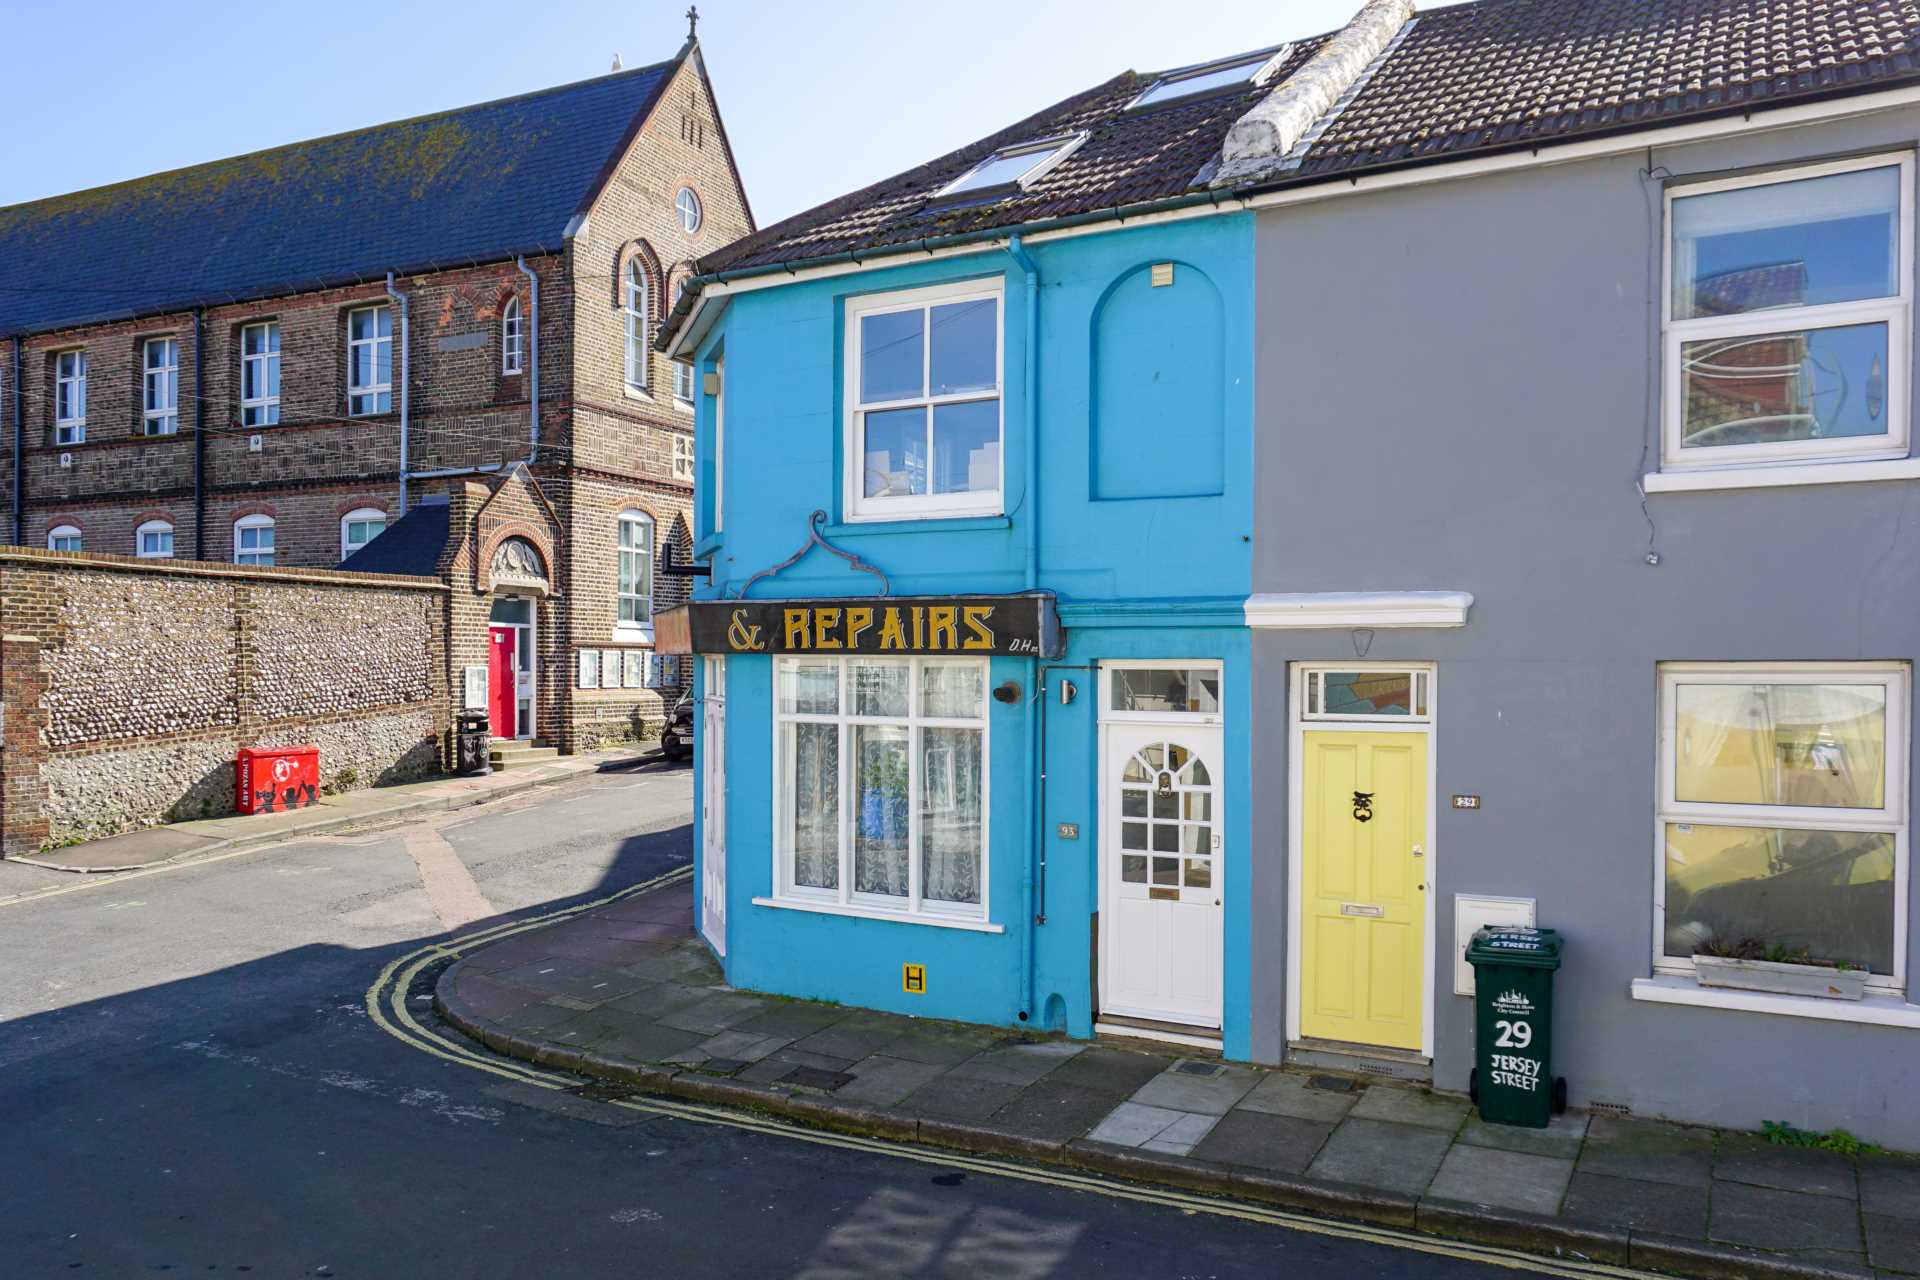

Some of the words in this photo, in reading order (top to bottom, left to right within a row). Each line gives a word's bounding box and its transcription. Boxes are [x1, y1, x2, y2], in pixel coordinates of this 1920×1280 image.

[727, 609, 764, 651] &
[783, 605, 996, 651] REPAIRS
[1460, 798, 1473, 806] 29
[1489, 934, 1542, 942] JERSEY
[1490, 941, 1540, 950] STREET
[906, 966, 923, 991] H
[1495, 1020, 1532, 1049] 29
[1491, 1054, 1542, 1077] JERSEY
[1491, 1070, 1540, 1092] STREET
